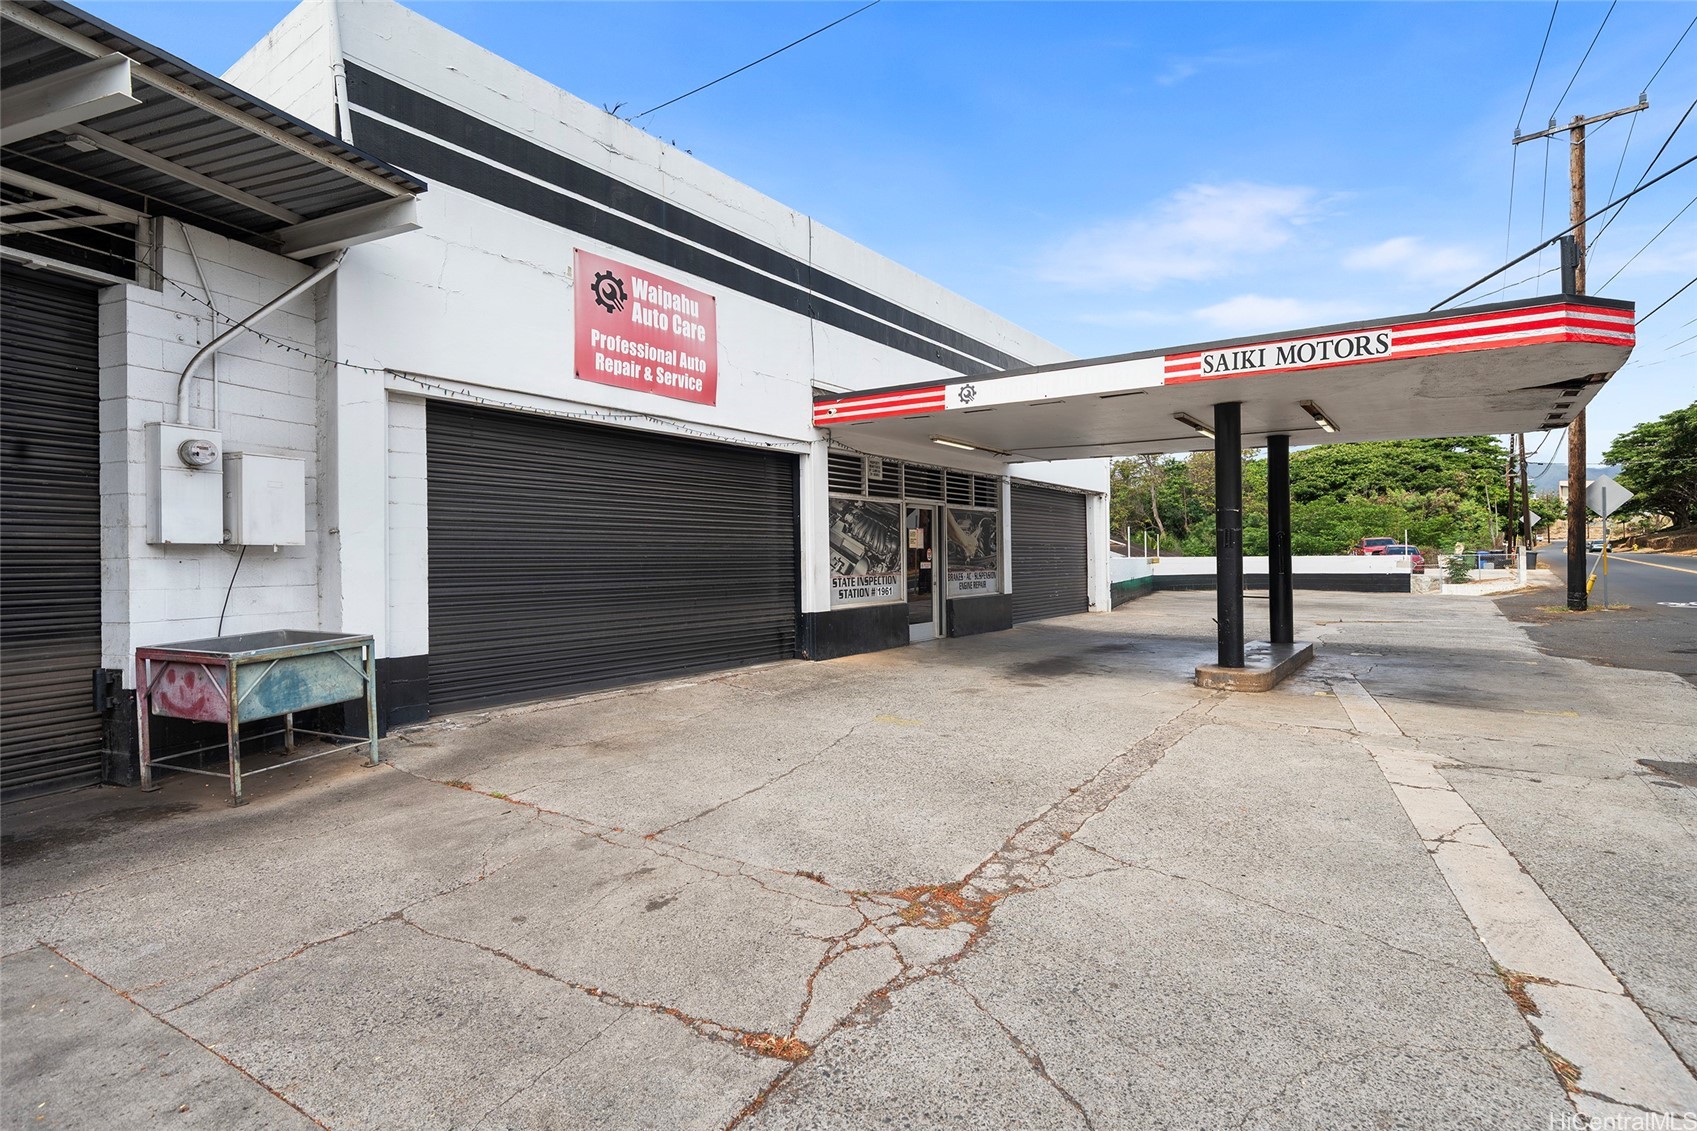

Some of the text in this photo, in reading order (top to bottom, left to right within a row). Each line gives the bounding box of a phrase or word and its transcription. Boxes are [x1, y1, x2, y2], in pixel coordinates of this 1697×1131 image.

[631, 276, 699, 317] Waipahu
[631, 301, 706, 342] Auto Care
[591, 328, 707, 373] Professional Auto
[1203, 333, 1389, 374] SAIKI MOTORS
[595, 352, 703, 392] Repair & Service
[832, 575, 897, 588] STATE INSPECTION
[838, 587, 893, 599] STATION # 1961
[948, 573, 964, 581] BRAKES
